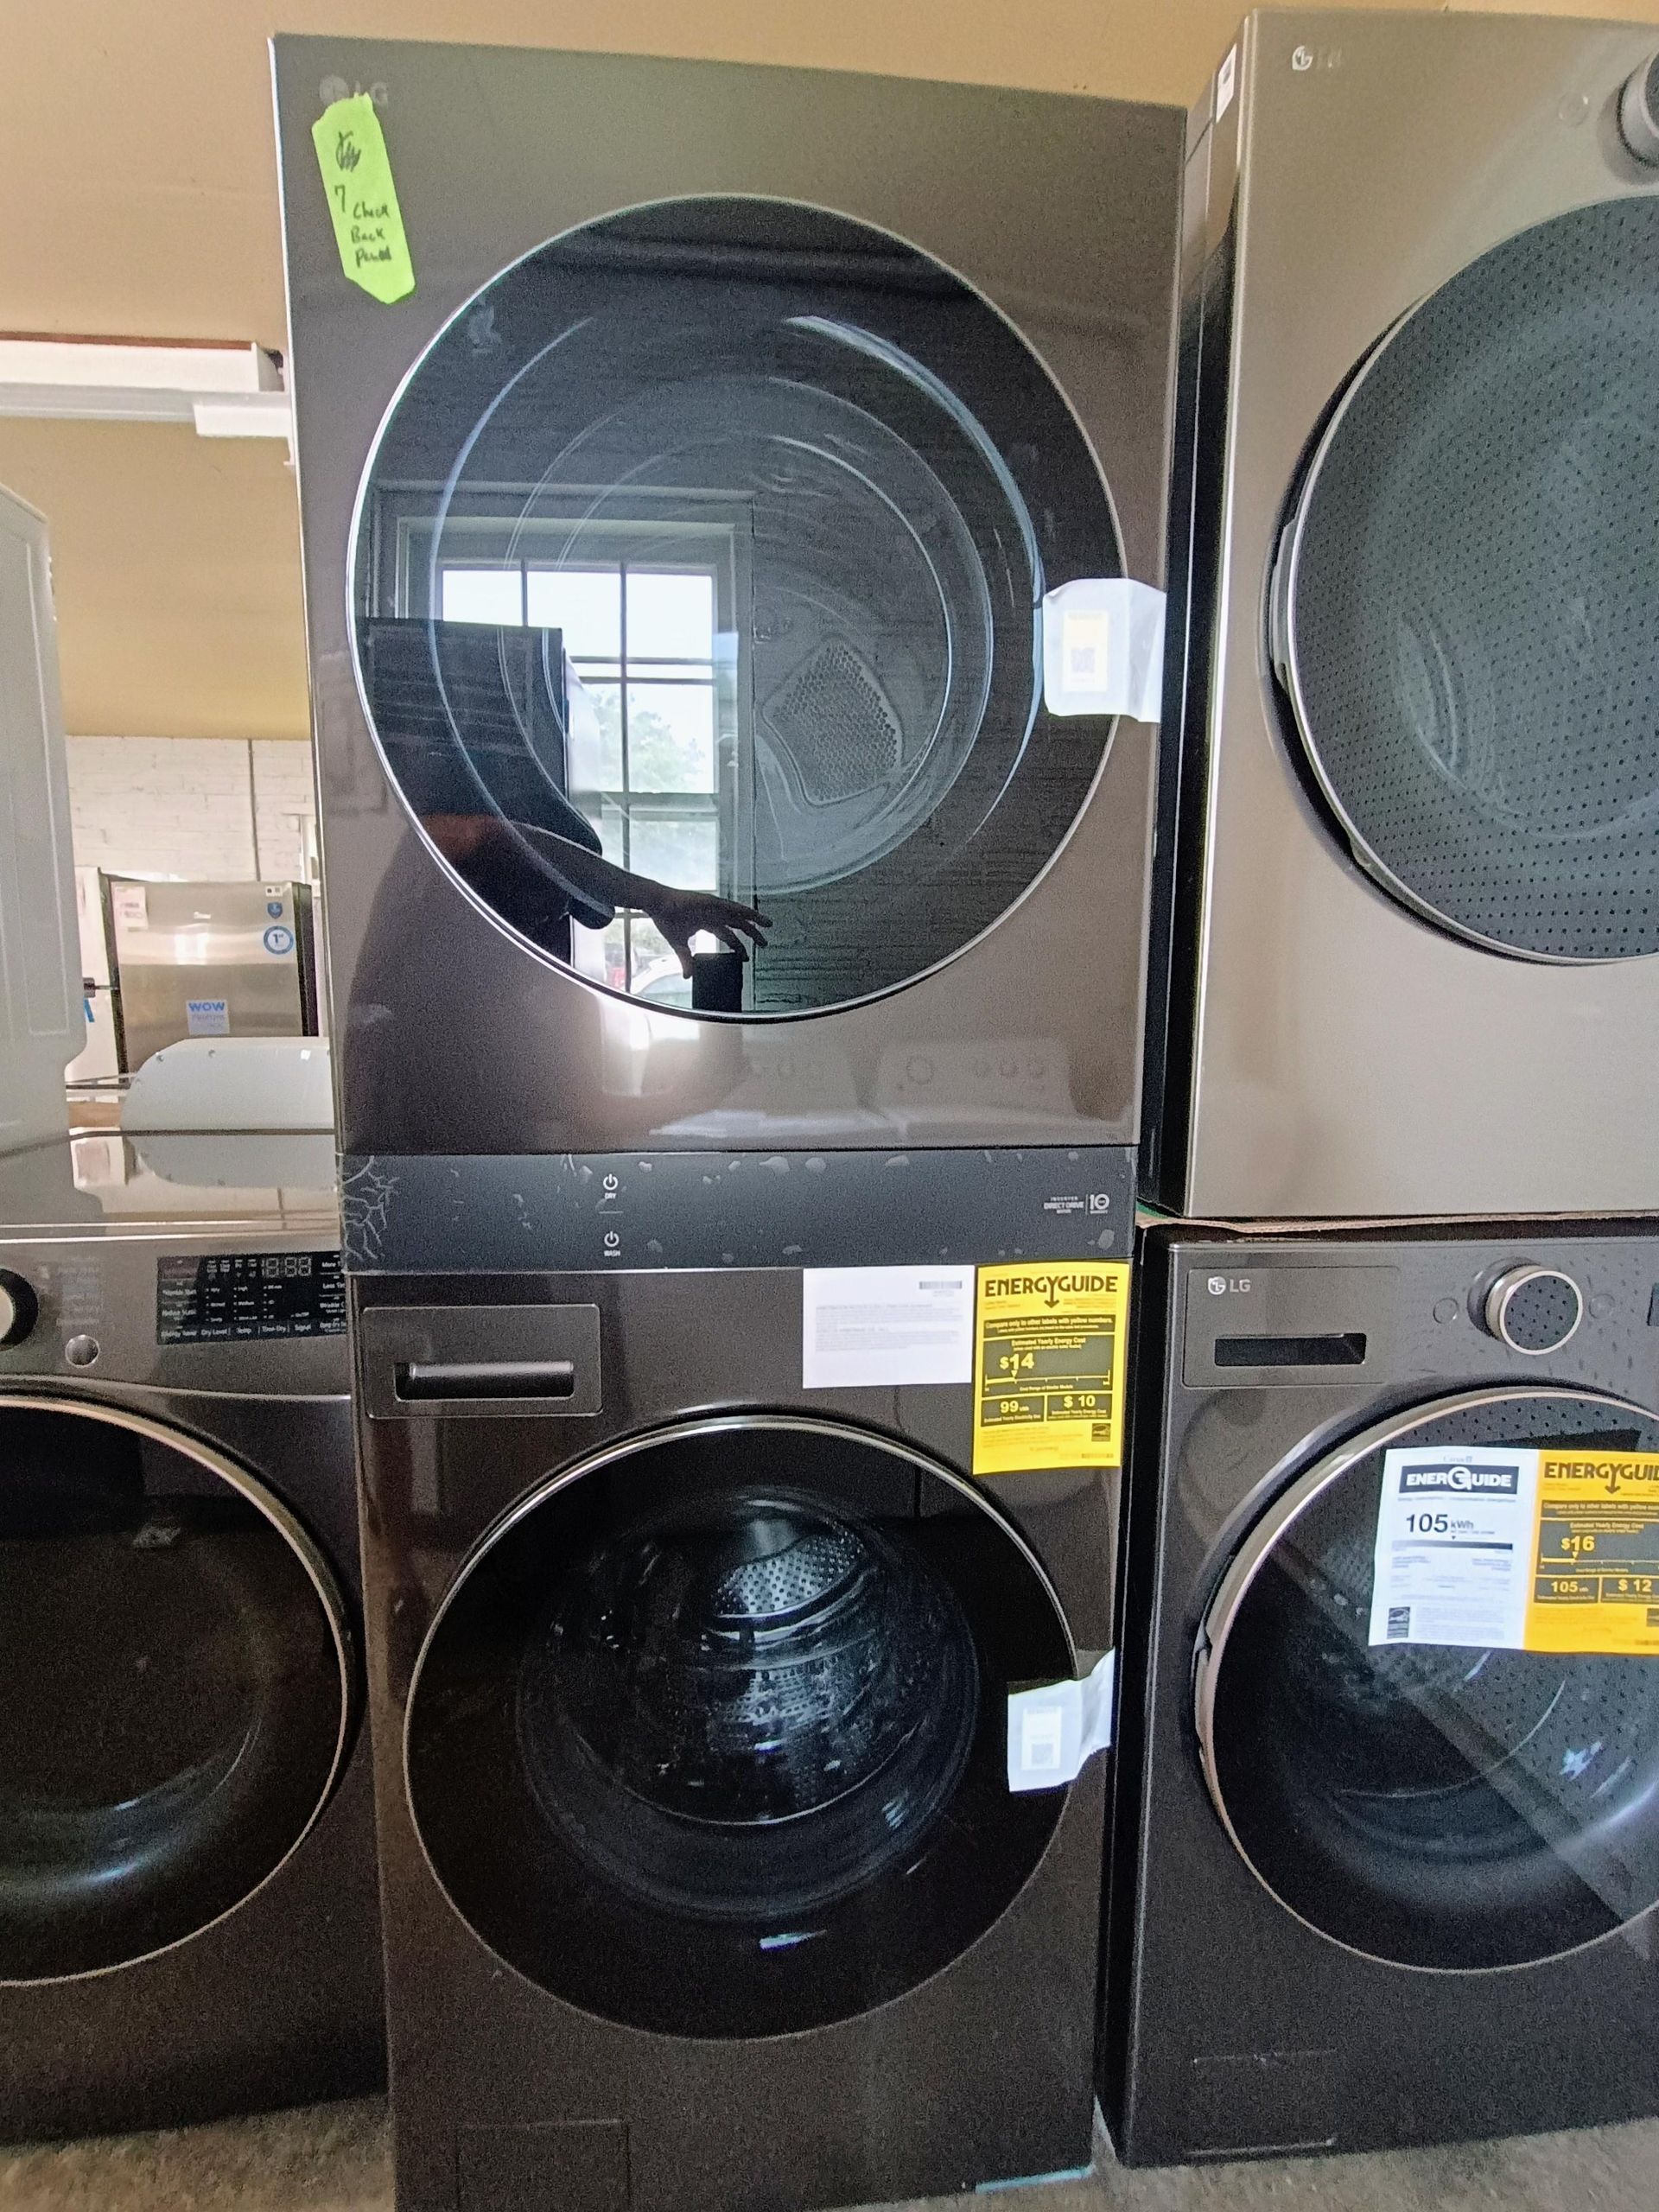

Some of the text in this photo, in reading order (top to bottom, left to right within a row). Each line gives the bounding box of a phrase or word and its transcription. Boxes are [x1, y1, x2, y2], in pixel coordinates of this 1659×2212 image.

[188, 1001, 226, 1012] WOW
[1090, 1193, 1110, 1210] 10
[984, 1274, 1119, 1300] ENERGYGUIDE
[1230, 1279, 1251, 1293] LG
[1000, 1352, 1034, 1370] $14
[1000, 1400, 1019, 1414] 99
[1063, 1395, 1096, 1408] $ 10
[1406, 1466, 1512, 1491] ENERGUIDE
[1406, 1513, 1474, 1533] 105 kWh
[1560, 1535, 1595, 1552] $16
[1550, 1581, 1579, 1592] 105
[1618, 1579, 1652, 1592] $ 12
